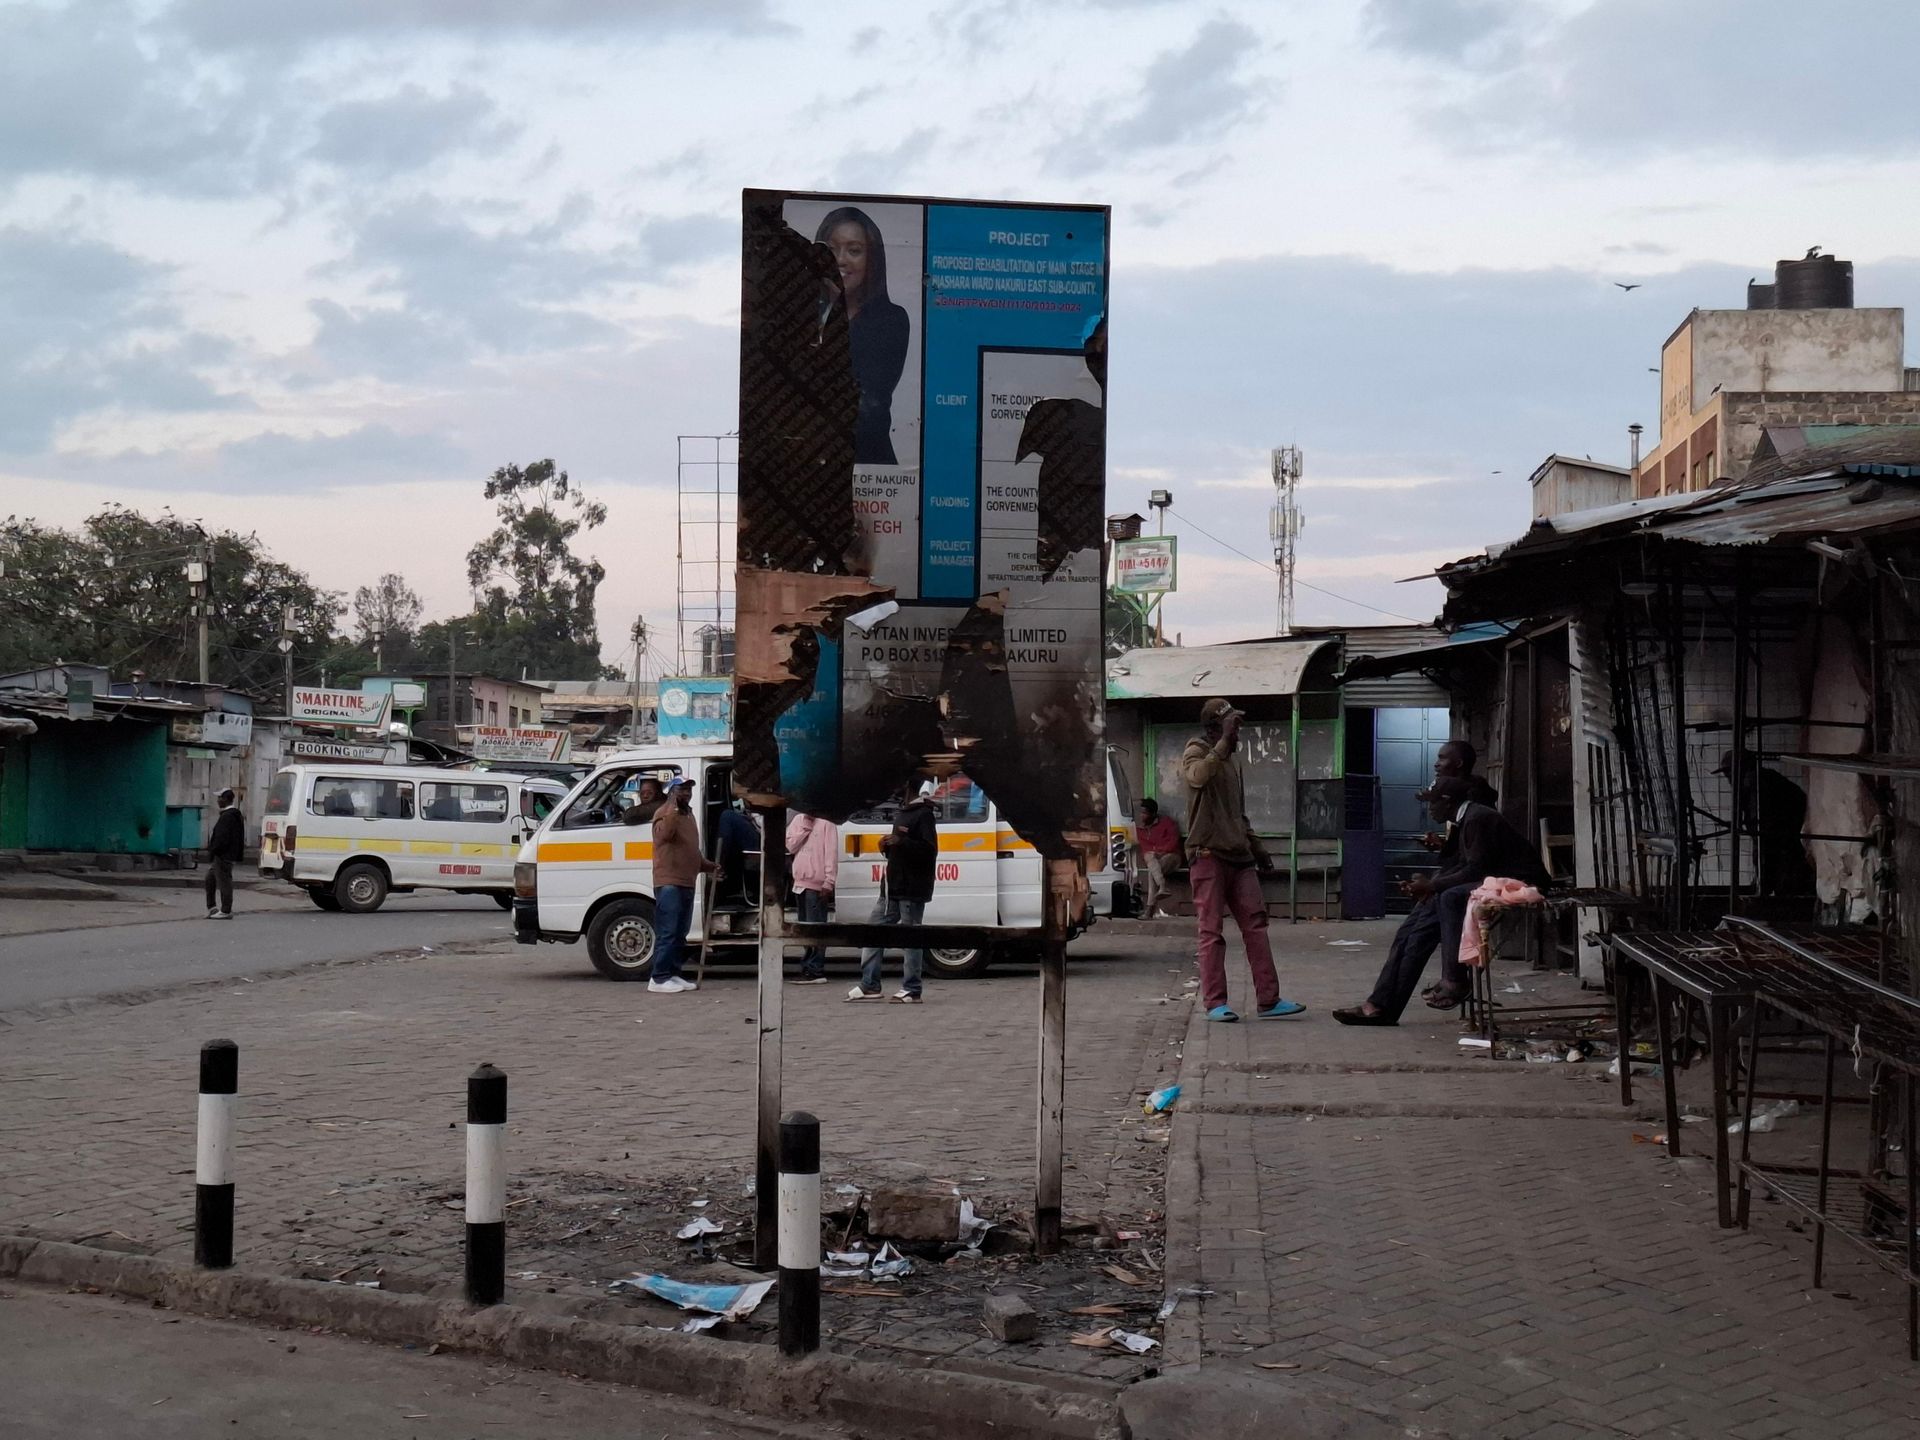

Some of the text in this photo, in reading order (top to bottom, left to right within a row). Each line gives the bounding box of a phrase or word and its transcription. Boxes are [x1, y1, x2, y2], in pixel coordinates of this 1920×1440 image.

[989, 231, 1050, 247] PROJECT
[932, 255, 974, 271] PROPOSED
[975, 258, 1035, 273] REHABILITATION
[1036, 260, 1046, 274] OF
[1048, 261, 1067, 275] MAIN
[1070, 262, 1095, 276] STAGE
[971, 276, 994, 290] WARD
[995, 278, 1026, 292] NAKURU
[1027, 279, 1047, 293] EAST
[935, 394, 968, 405] CLIENT
[991, 394, 1007, 405] THE
[860, 475, 873, 485] OF
[875, 475, 916, 486] NAKURU
[886, 489, 899, 498] OF
[986, 486, 1039, 498] THE COUNTY
[852, 501, 889, 515] RNOR
[930, 496, 970, 509] FUNDING
[873, 521, 902, 535] EGH
[929, 540, 972, 552] PROJECT
[929, 555, 975, 567] MANAGER
[1009, 629, 1067, 643] LIMITED
[861, 648, 884, 663] P.O
[888, 649, 919, 663] BOX
[1008, 650, 1059, 664] AKURU
[295, 692, 364, 709] SMARTLINE
[303, 708, 351, 717] ORIGINAL
[297, 743, 351, 757] BOOKING
[934, 863, 959, 881] CCO
